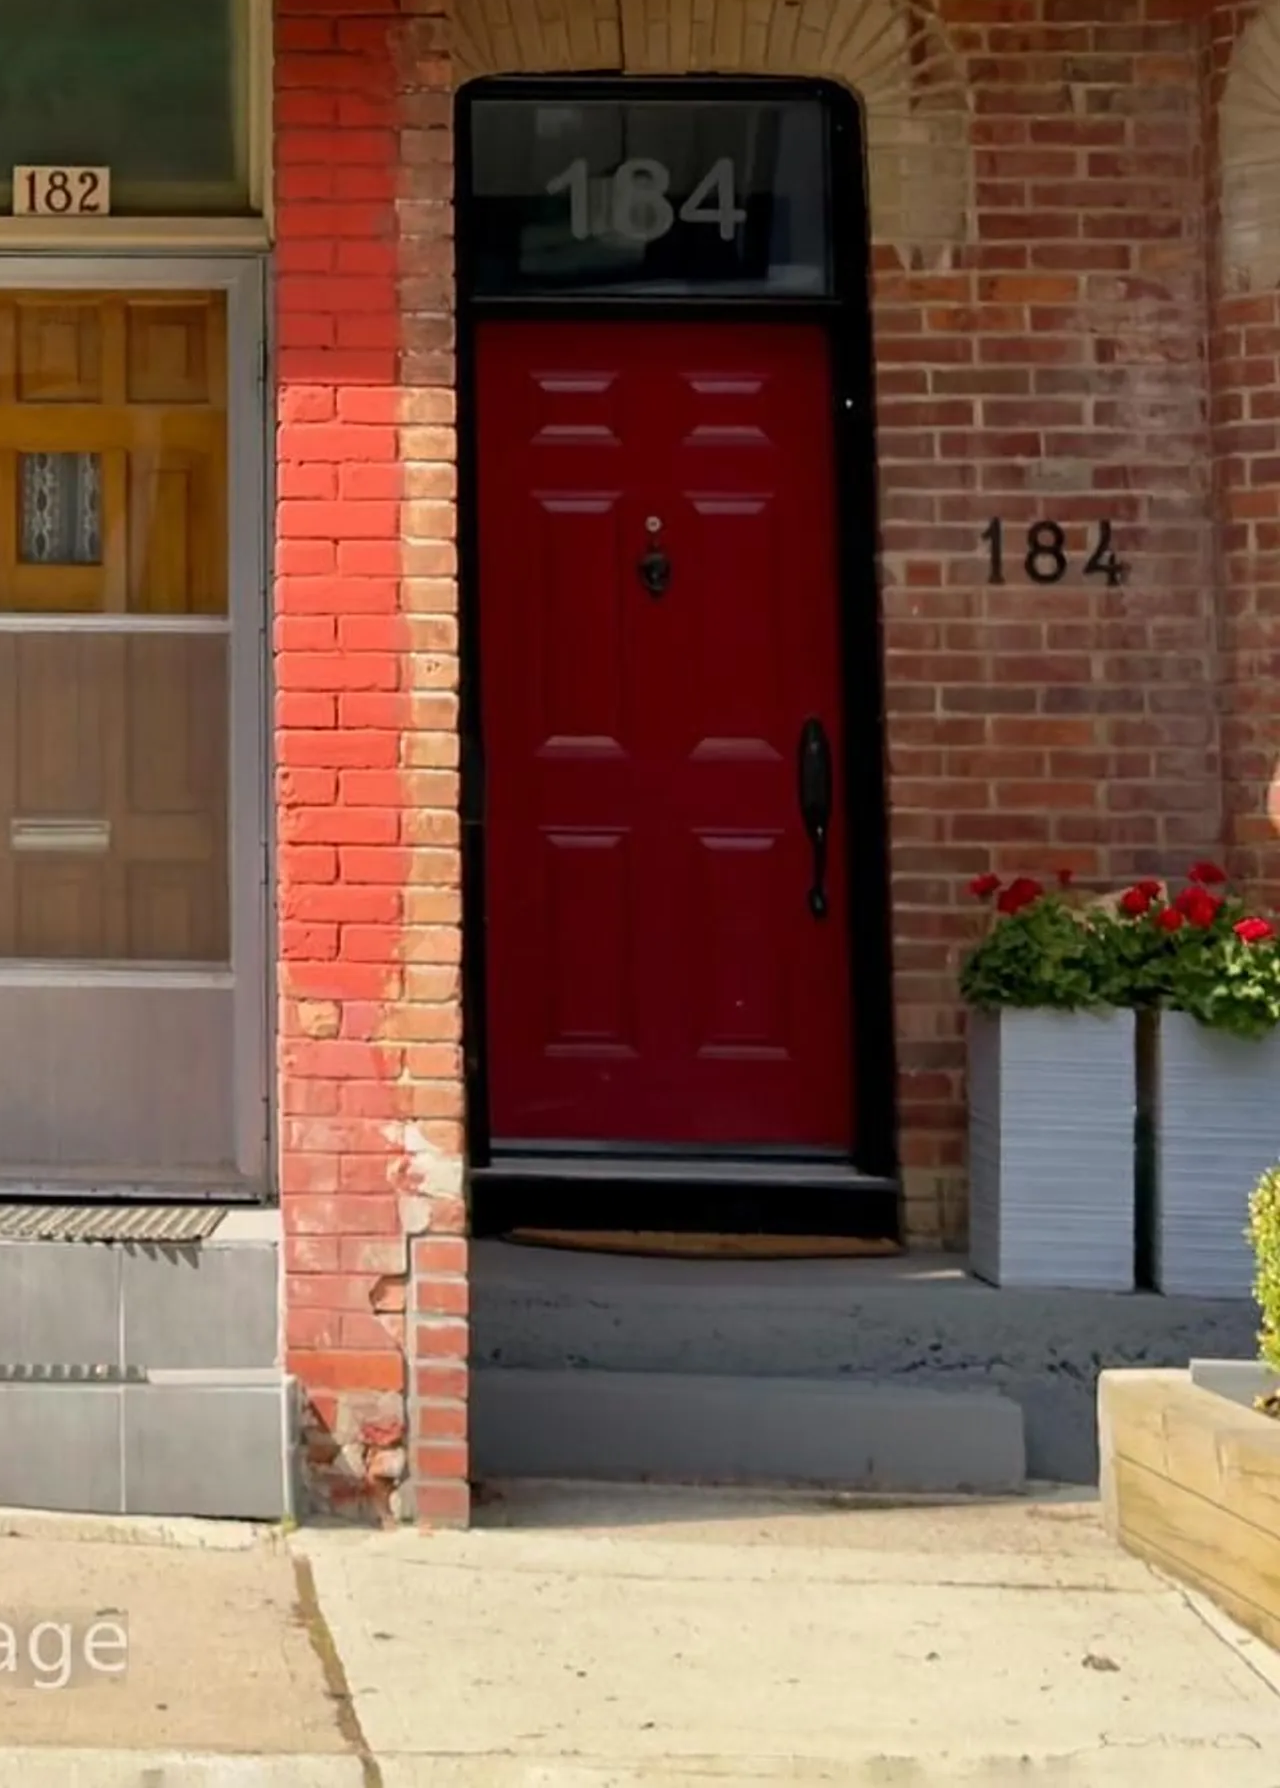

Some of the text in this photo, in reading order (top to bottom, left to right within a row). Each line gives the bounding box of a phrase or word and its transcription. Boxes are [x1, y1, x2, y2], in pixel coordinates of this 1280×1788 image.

[24, 169, 100, 213] 182
[545, 157, 747, 241] 184
[980, 516, 1131, 587] 184
